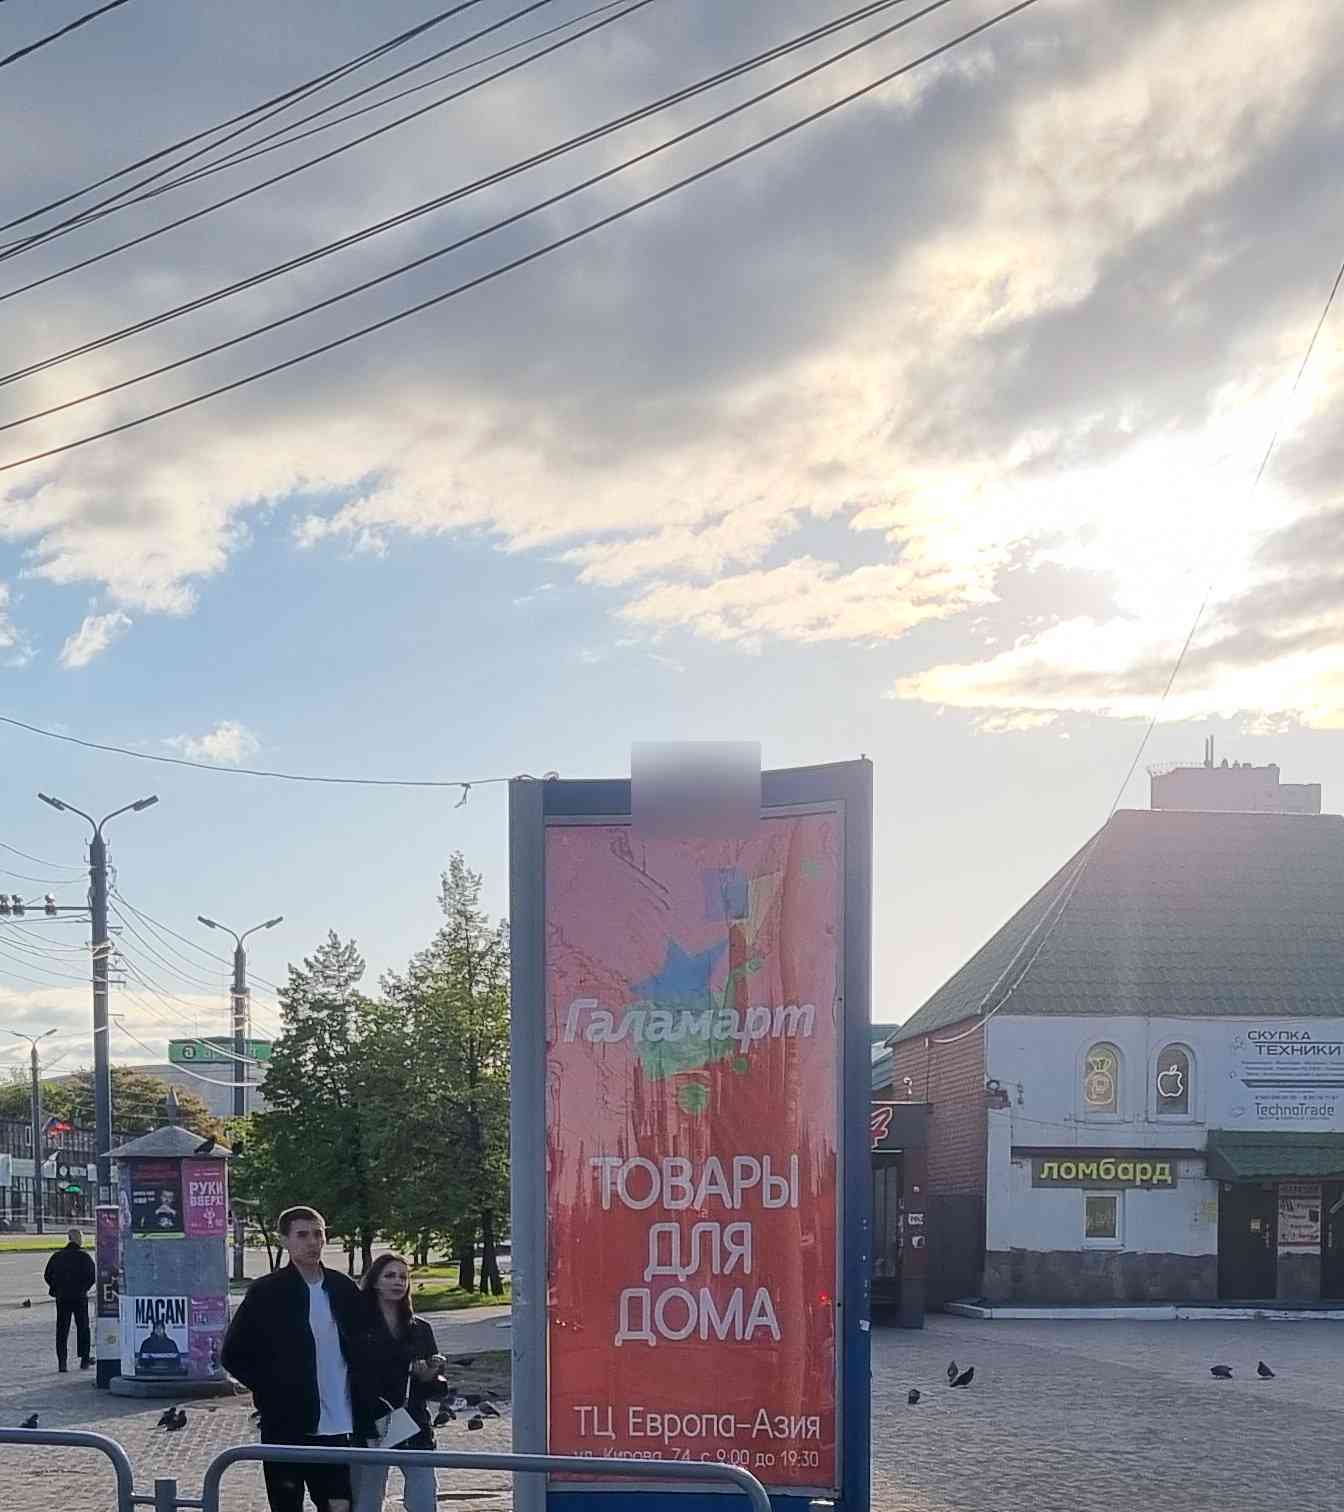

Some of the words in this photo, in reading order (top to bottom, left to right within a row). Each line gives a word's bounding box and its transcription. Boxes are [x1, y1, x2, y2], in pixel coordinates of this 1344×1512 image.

[563, 998, 816, 1054] Галамарт
[1247, 1030, 1312, 1041] СКУПКА
[1256, 1044, 1342, 1056] ТЕХНИКИ
[1255, 1102, 1335, 1117] TechnoTrade
[589, 1154, 800, 1210] ТОВАРЫ
[1040, 1158, 1172, 1186] ломбард
[643, 1221, 752, 1282] ДЛЯ
[136, 1299, 185, 1325] MACAN
[614, 1286, 782, 1347] ДОМА
[573, 1406, 616, 1440] ТЦ
[716, 1450, 749, 1466] 9:00
[755, 1453, 775, 1467] до
[781, 1451, 819, 1468] 19:30
